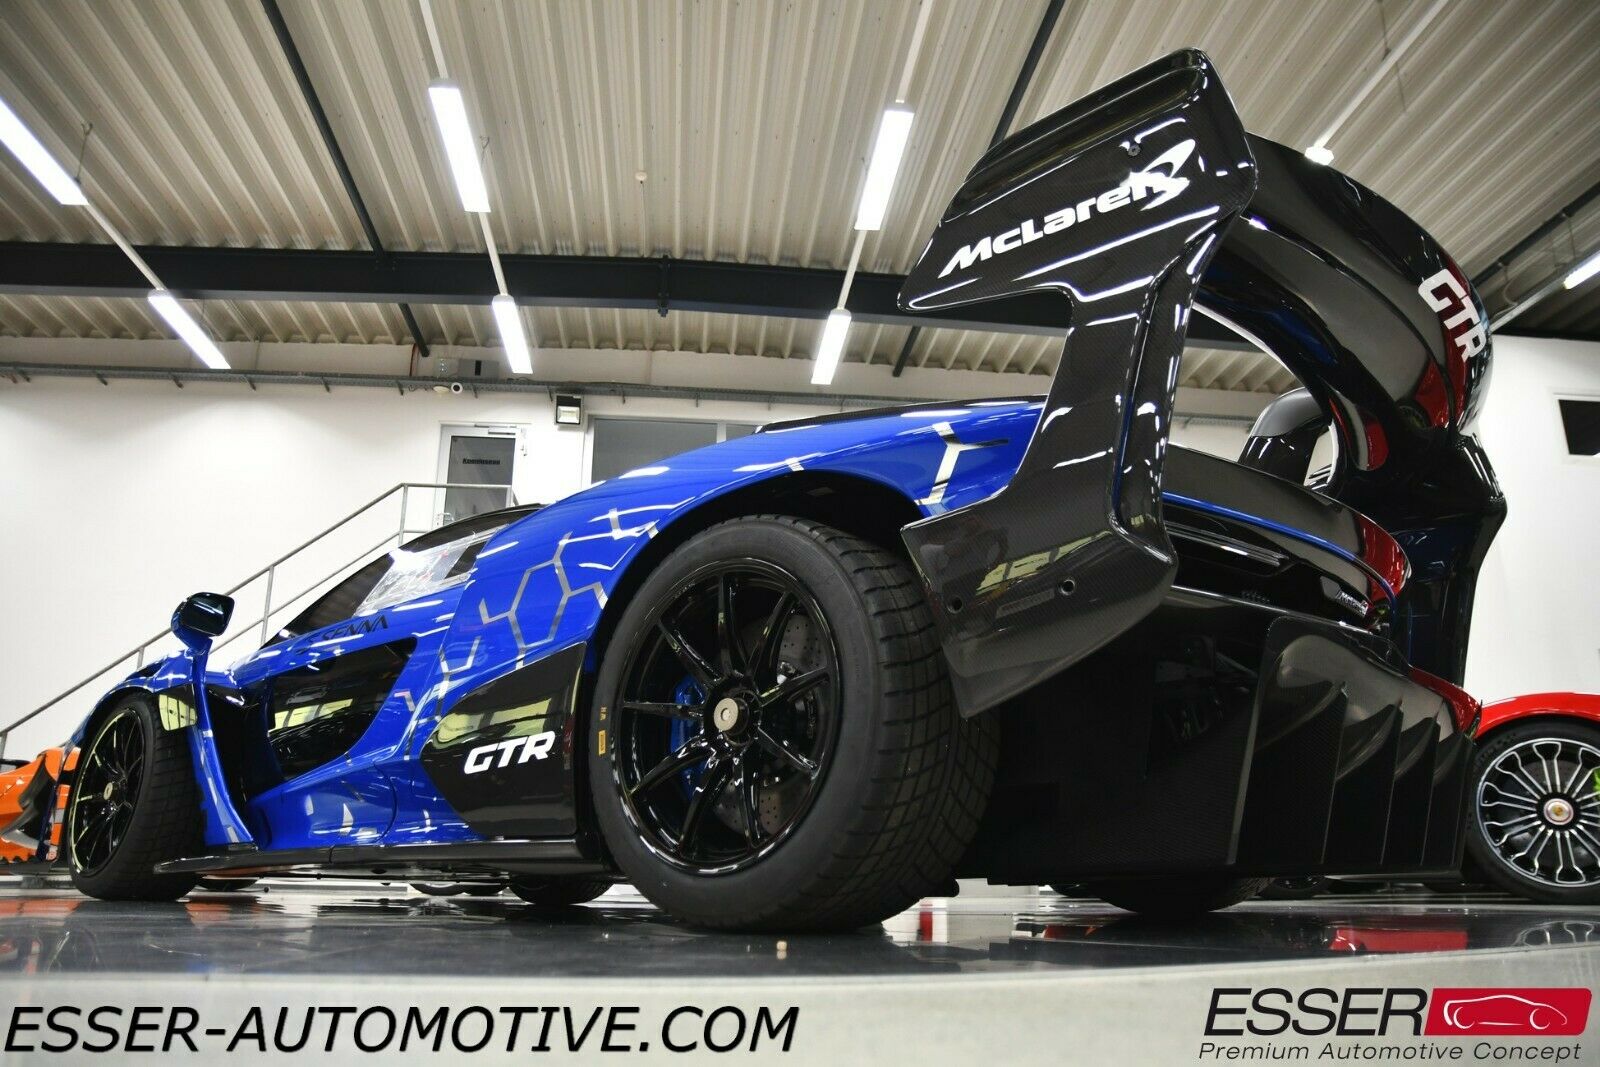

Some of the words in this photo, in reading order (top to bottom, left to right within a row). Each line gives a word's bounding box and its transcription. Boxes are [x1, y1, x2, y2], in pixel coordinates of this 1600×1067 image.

[937, 178, 1166, 279] McLaren
[1418, 268, 1487, 363] GTR
[463, 730, 556, 775] GTR
